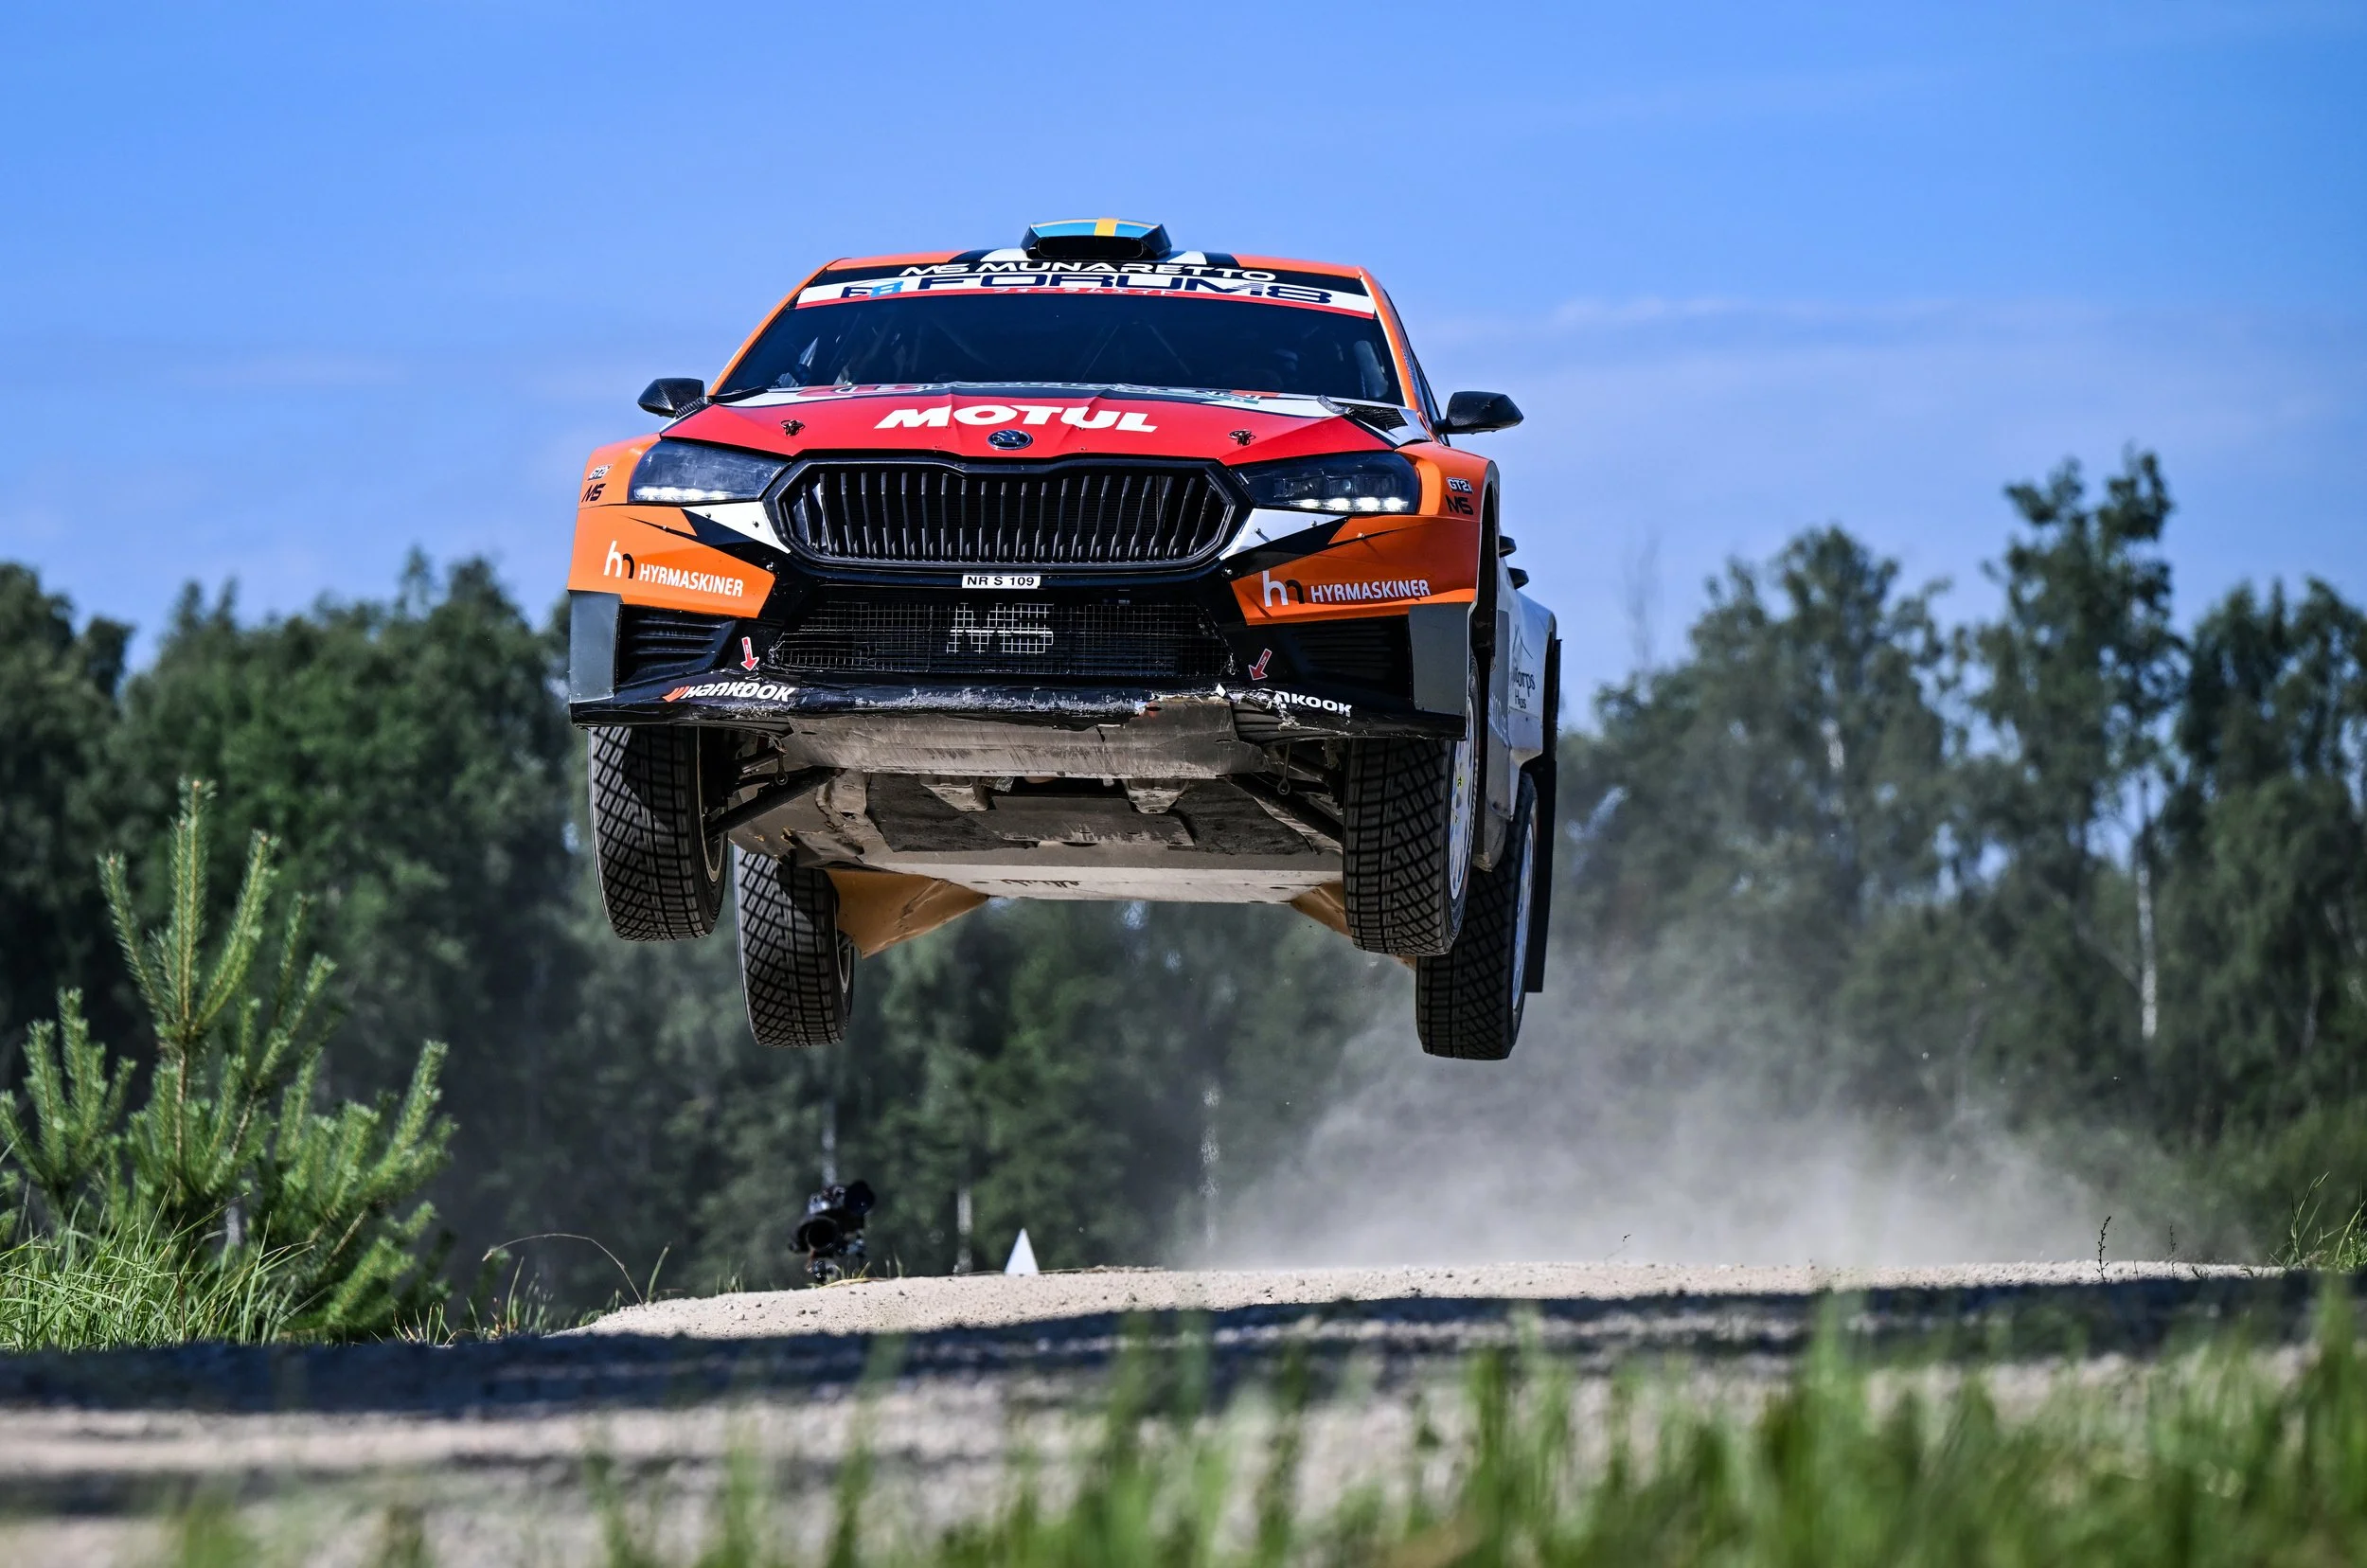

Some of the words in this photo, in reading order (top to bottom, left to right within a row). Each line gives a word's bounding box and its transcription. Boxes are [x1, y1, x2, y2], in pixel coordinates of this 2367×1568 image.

[899, 263, 970, 276] MS
[975, 261, 1276, 282] MUNARETTO
[917, 274, 1332, 304] FORUM8
[873, 404, 1158, 433] MOTUL
[638, 563, 744, 597] HYRMASKINER
[967, 576, 988, 586] NR
[993, 576, 1004, 586] S
[1009, 577, 1035, 586] 109
[1310, 579, 1432, 603] HYRMASKINER
